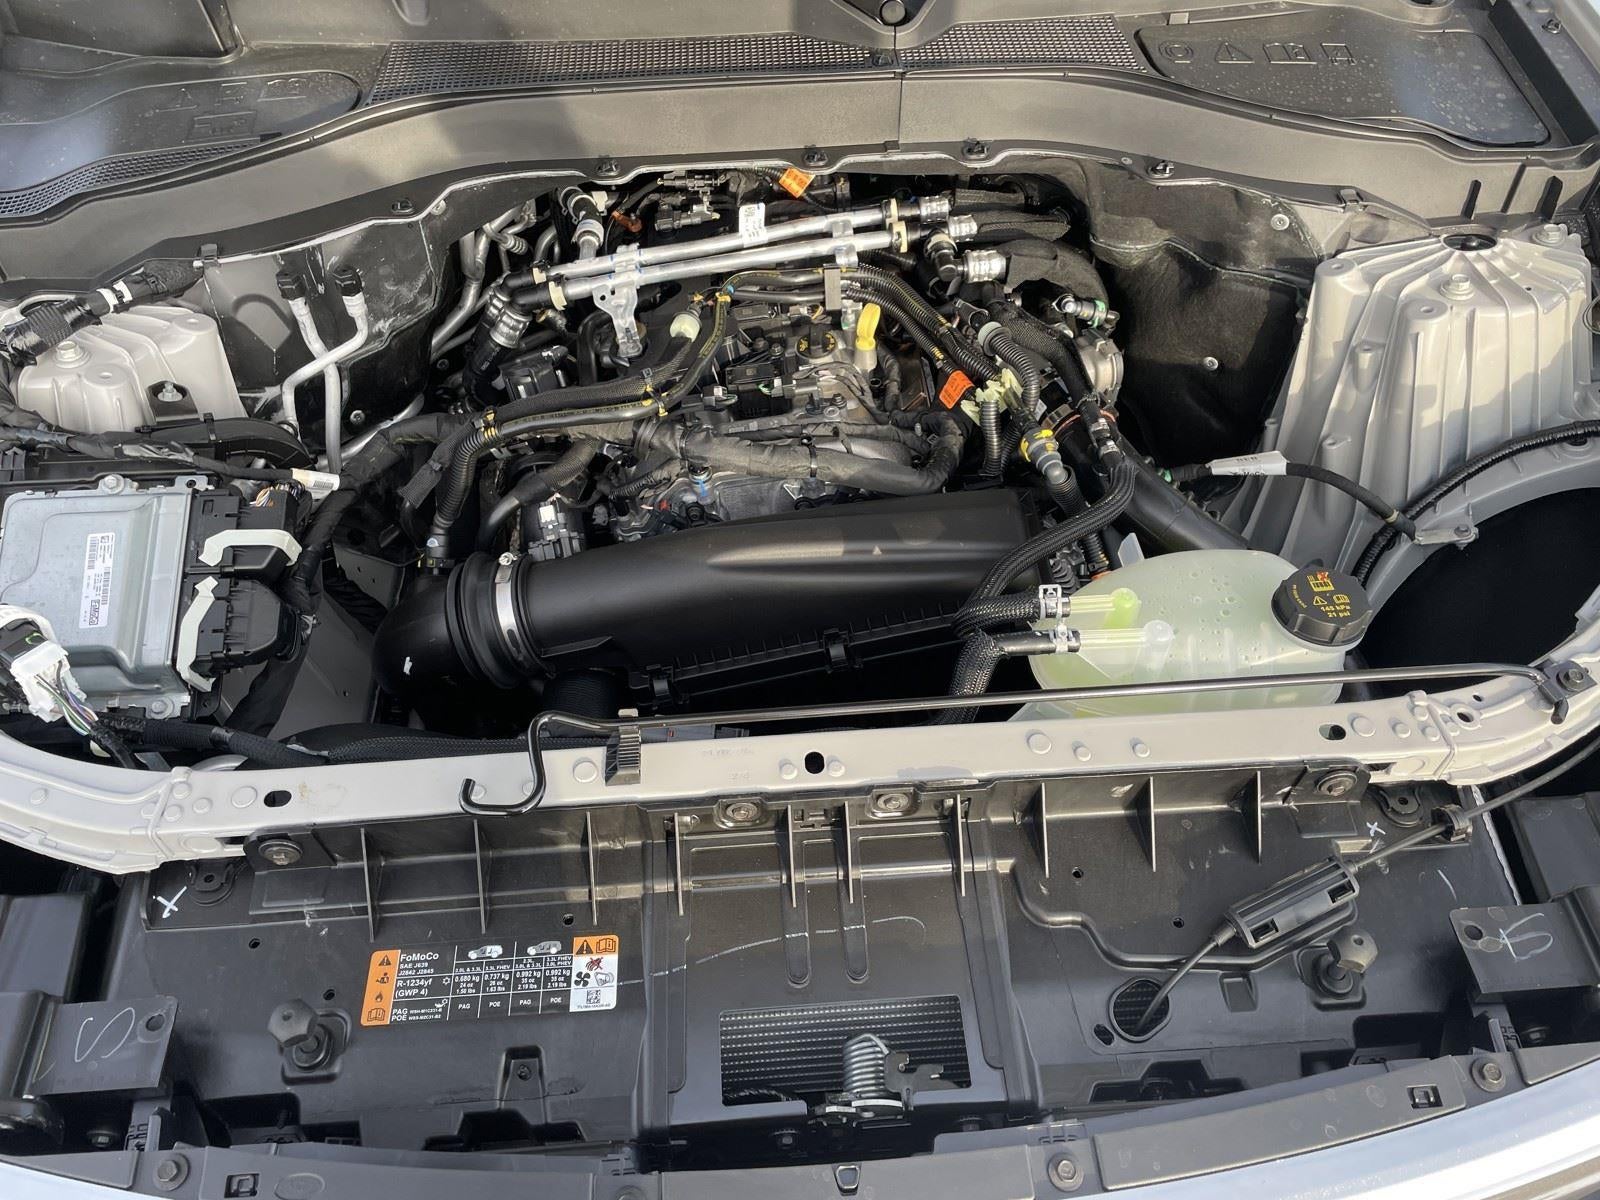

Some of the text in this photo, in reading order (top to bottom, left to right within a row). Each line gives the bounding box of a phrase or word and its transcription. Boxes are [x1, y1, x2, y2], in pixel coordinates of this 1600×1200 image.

[400, 952, 440, 962] FoMoCo
[397, 978, 433, 987] R-1234yf
[395, 990, 419, 998] (GWP
